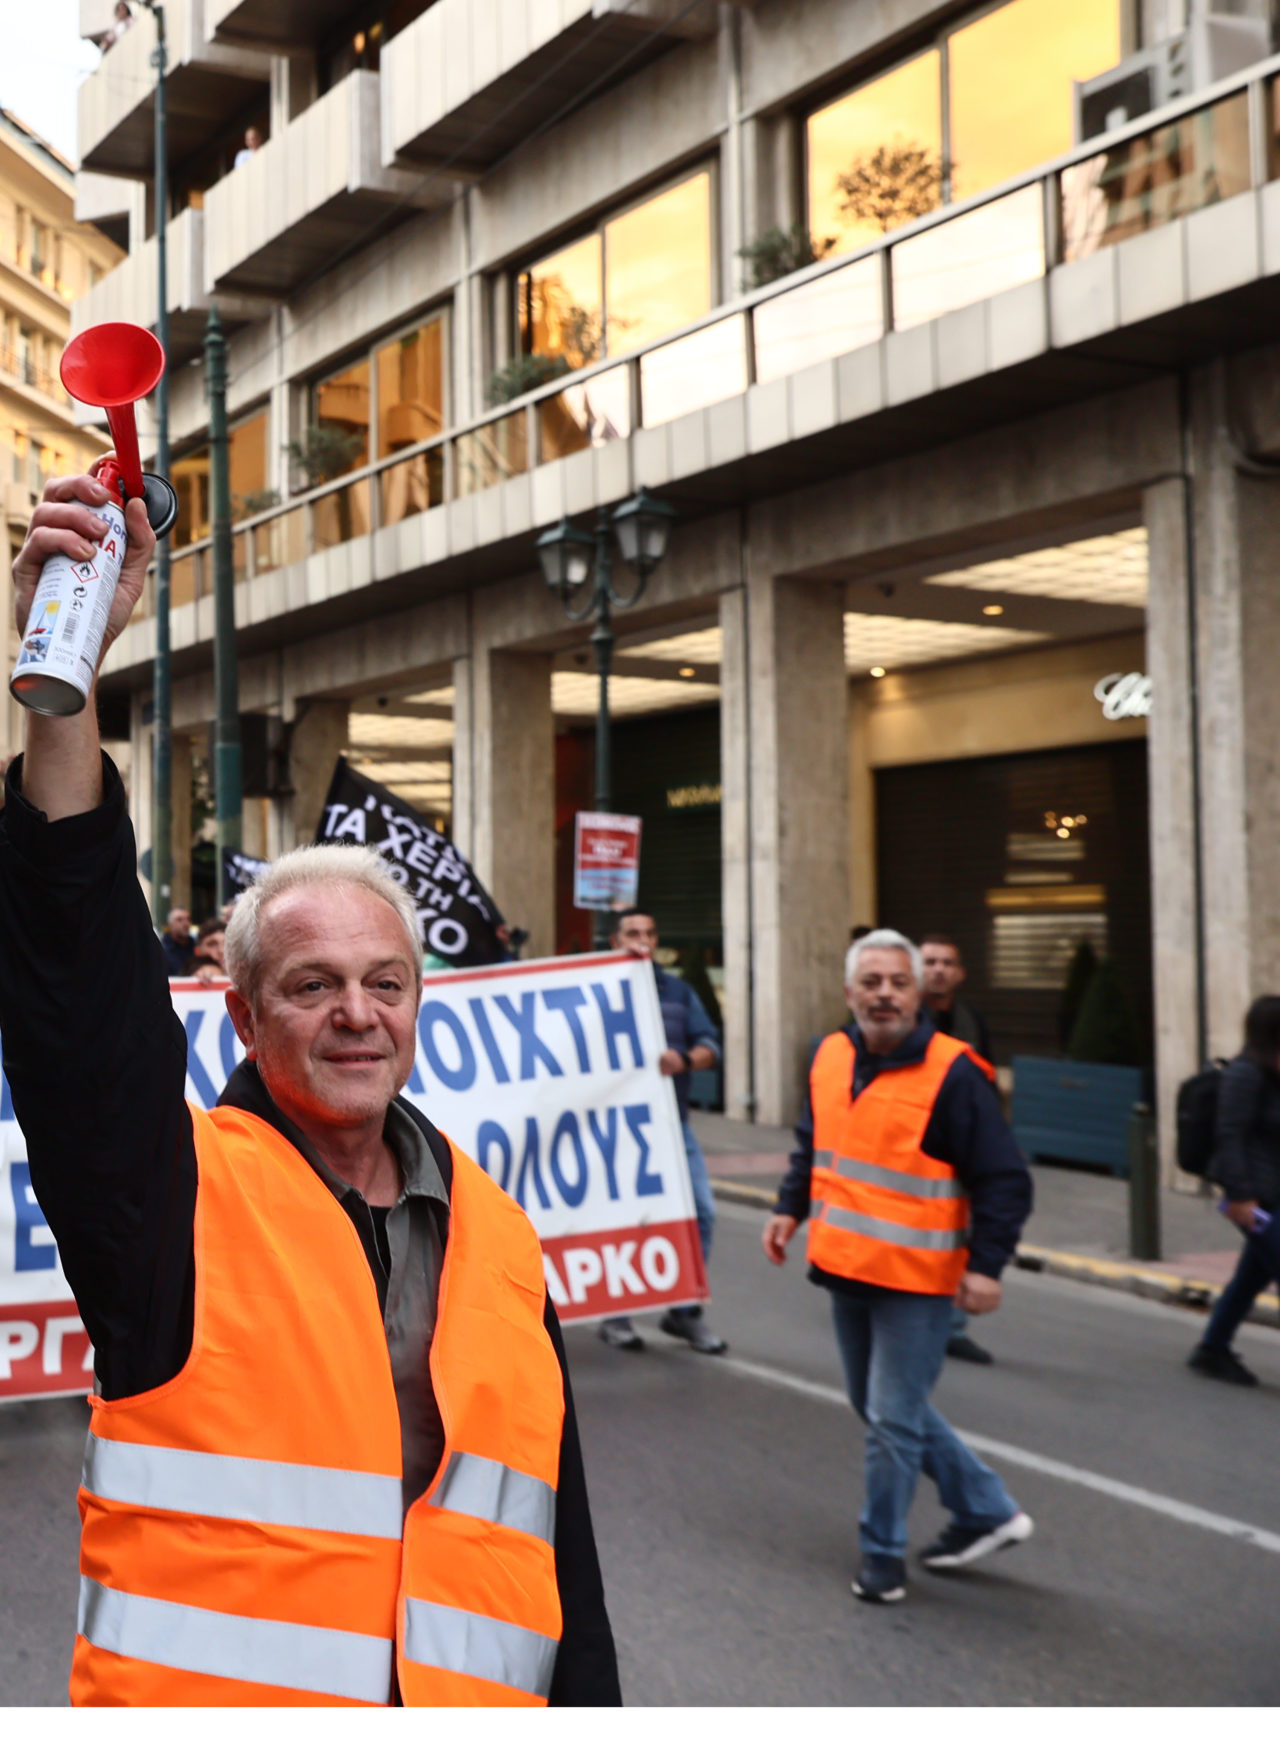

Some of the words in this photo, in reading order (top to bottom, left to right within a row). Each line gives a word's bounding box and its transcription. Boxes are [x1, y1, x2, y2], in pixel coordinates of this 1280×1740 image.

[324, 804, 368, 842] ΤΑ
[416, 876, 453, 911] ΤΗ
[413, 979, 646, 1096] ΟΙΧΤΗ
[544, 1235, 680, 1308] ΑΡΚΟ
